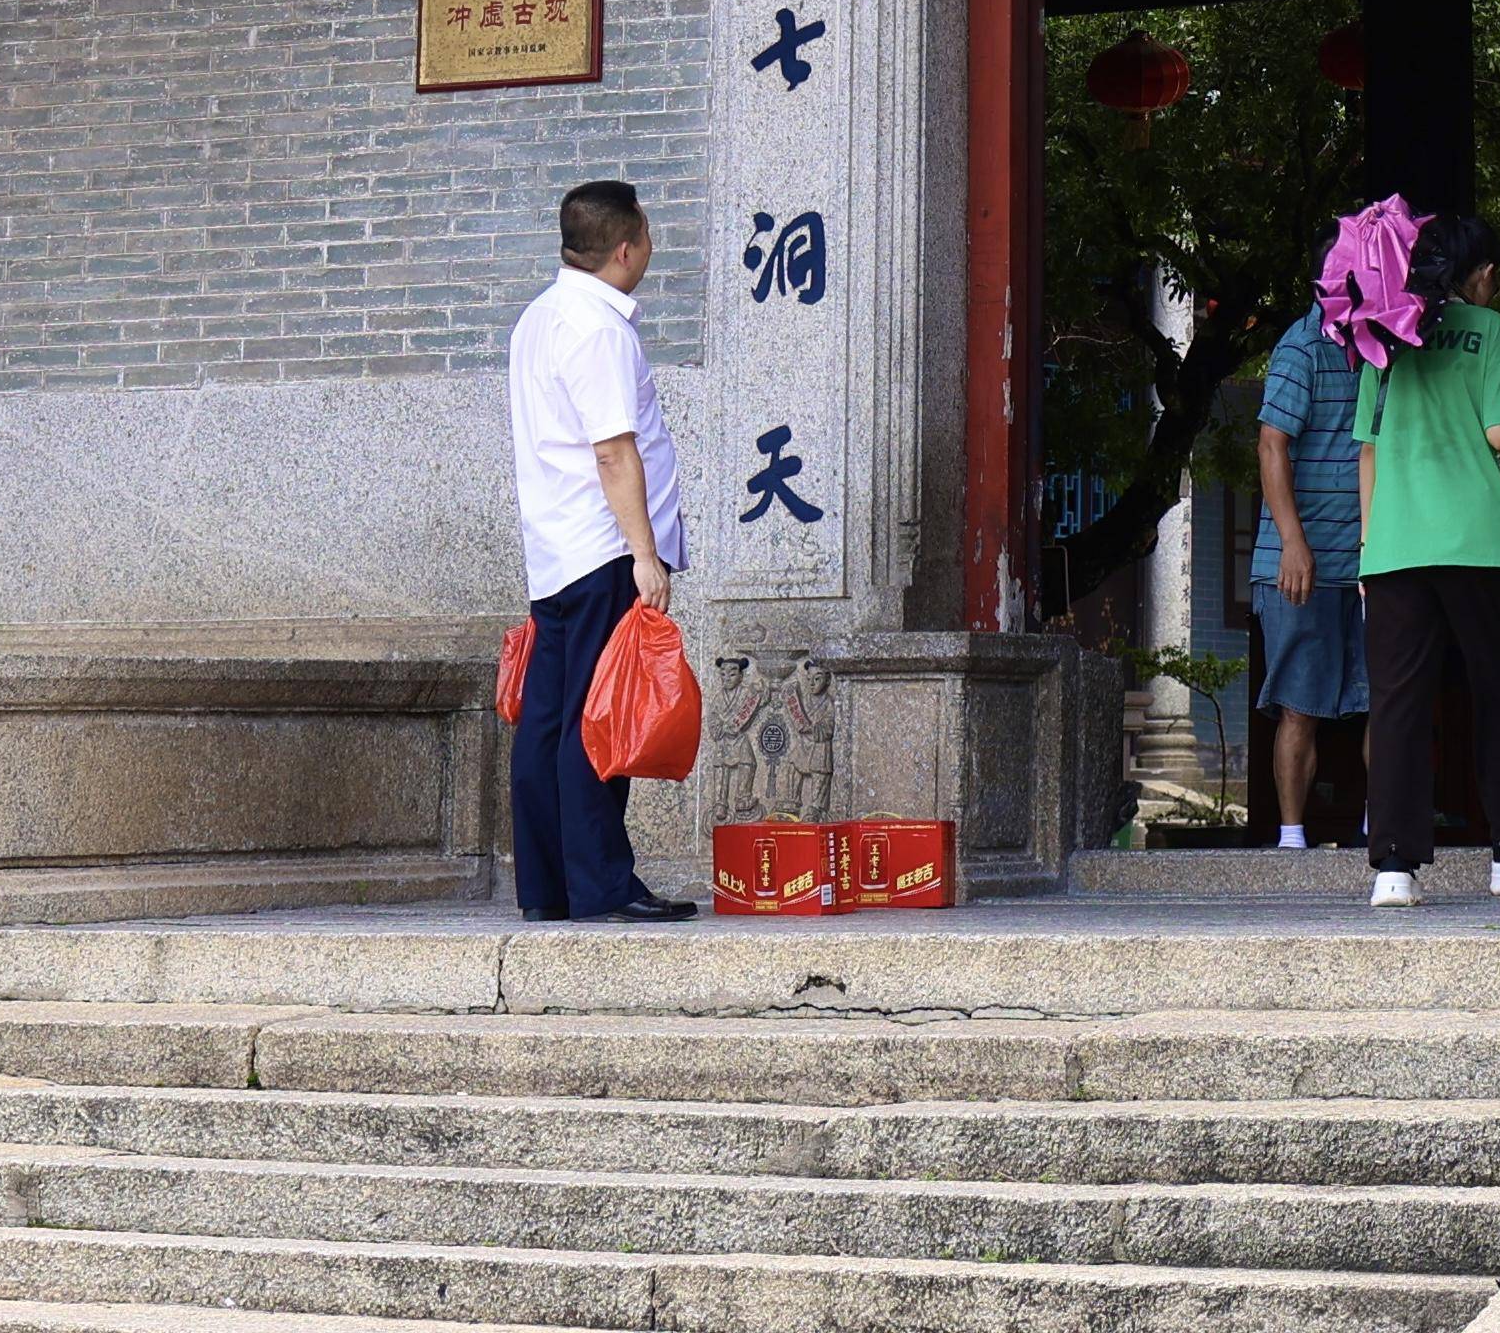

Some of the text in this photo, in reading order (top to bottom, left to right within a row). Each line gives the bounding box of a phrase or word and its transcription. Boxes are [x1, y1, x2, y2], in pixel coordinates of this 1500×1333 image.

[718, 868, 748, 897] 怕上火
[839, 836, 852, 891] 王老吉
